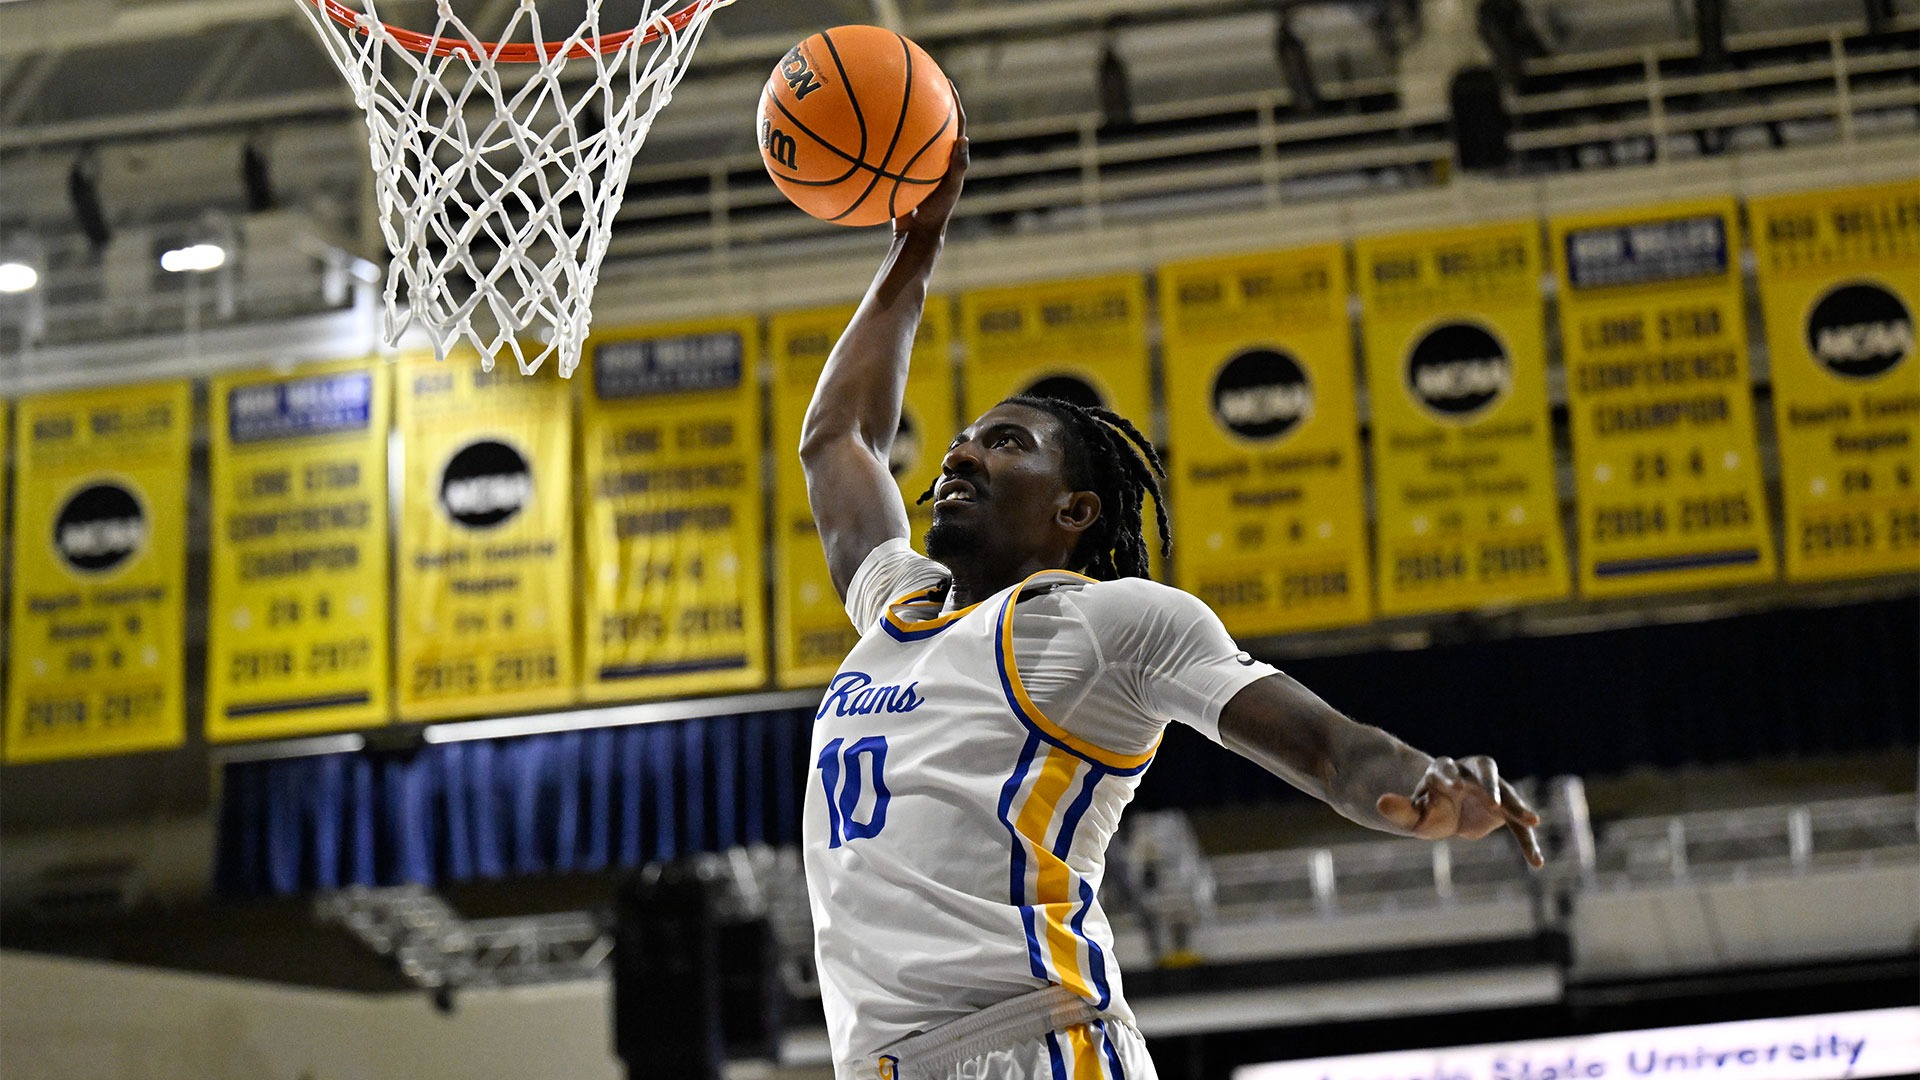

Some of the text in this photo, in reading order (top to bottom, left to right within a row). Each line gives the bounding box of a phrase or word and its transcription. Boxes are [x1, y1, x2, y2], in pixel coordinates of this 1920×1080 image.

[1580, 307, 1721, 350] LONE STAR
[1816, 319, 1914, 361] NCAA
[1416, 358, 1512, 400] NCAA
[1579, 352, 1737, 393] CONFERENCE
[1219, 384, 1312, 425] NCAA
[1593, 395, 1728, 435] CHAMPION
[447, 474, 531, 515] NCAA
[62, 517, 144, 556] NCAA
[816, 671, 926, 720] Rams
[816, 735, 892, 849] 10
[1627, 1034, 1867, 1078] University
